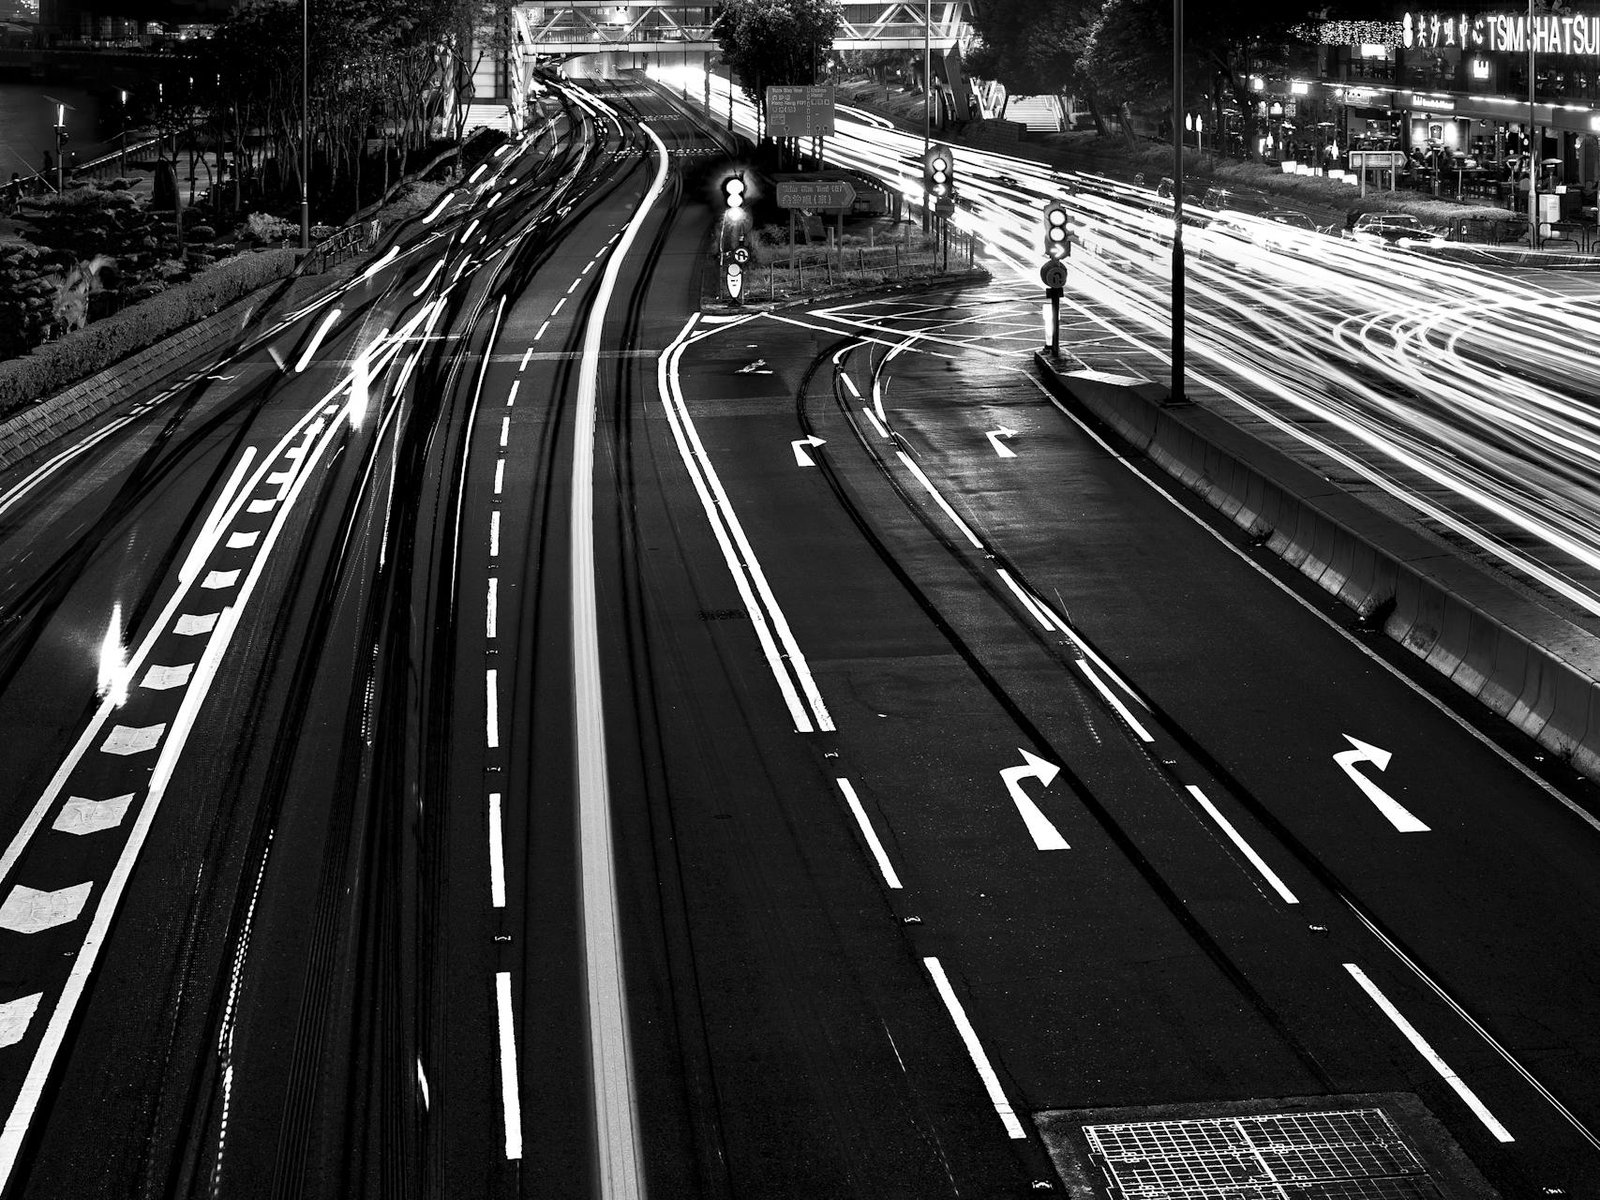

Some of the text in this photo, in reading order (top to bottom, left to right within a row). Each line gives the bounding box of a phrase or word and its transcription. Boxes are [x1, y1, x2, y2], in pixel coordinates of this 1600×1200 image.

[1417, 13, 1484, 51] 尖沙咀中心
[1487, 14, 1600, 55] TSIM SHA TSUI
